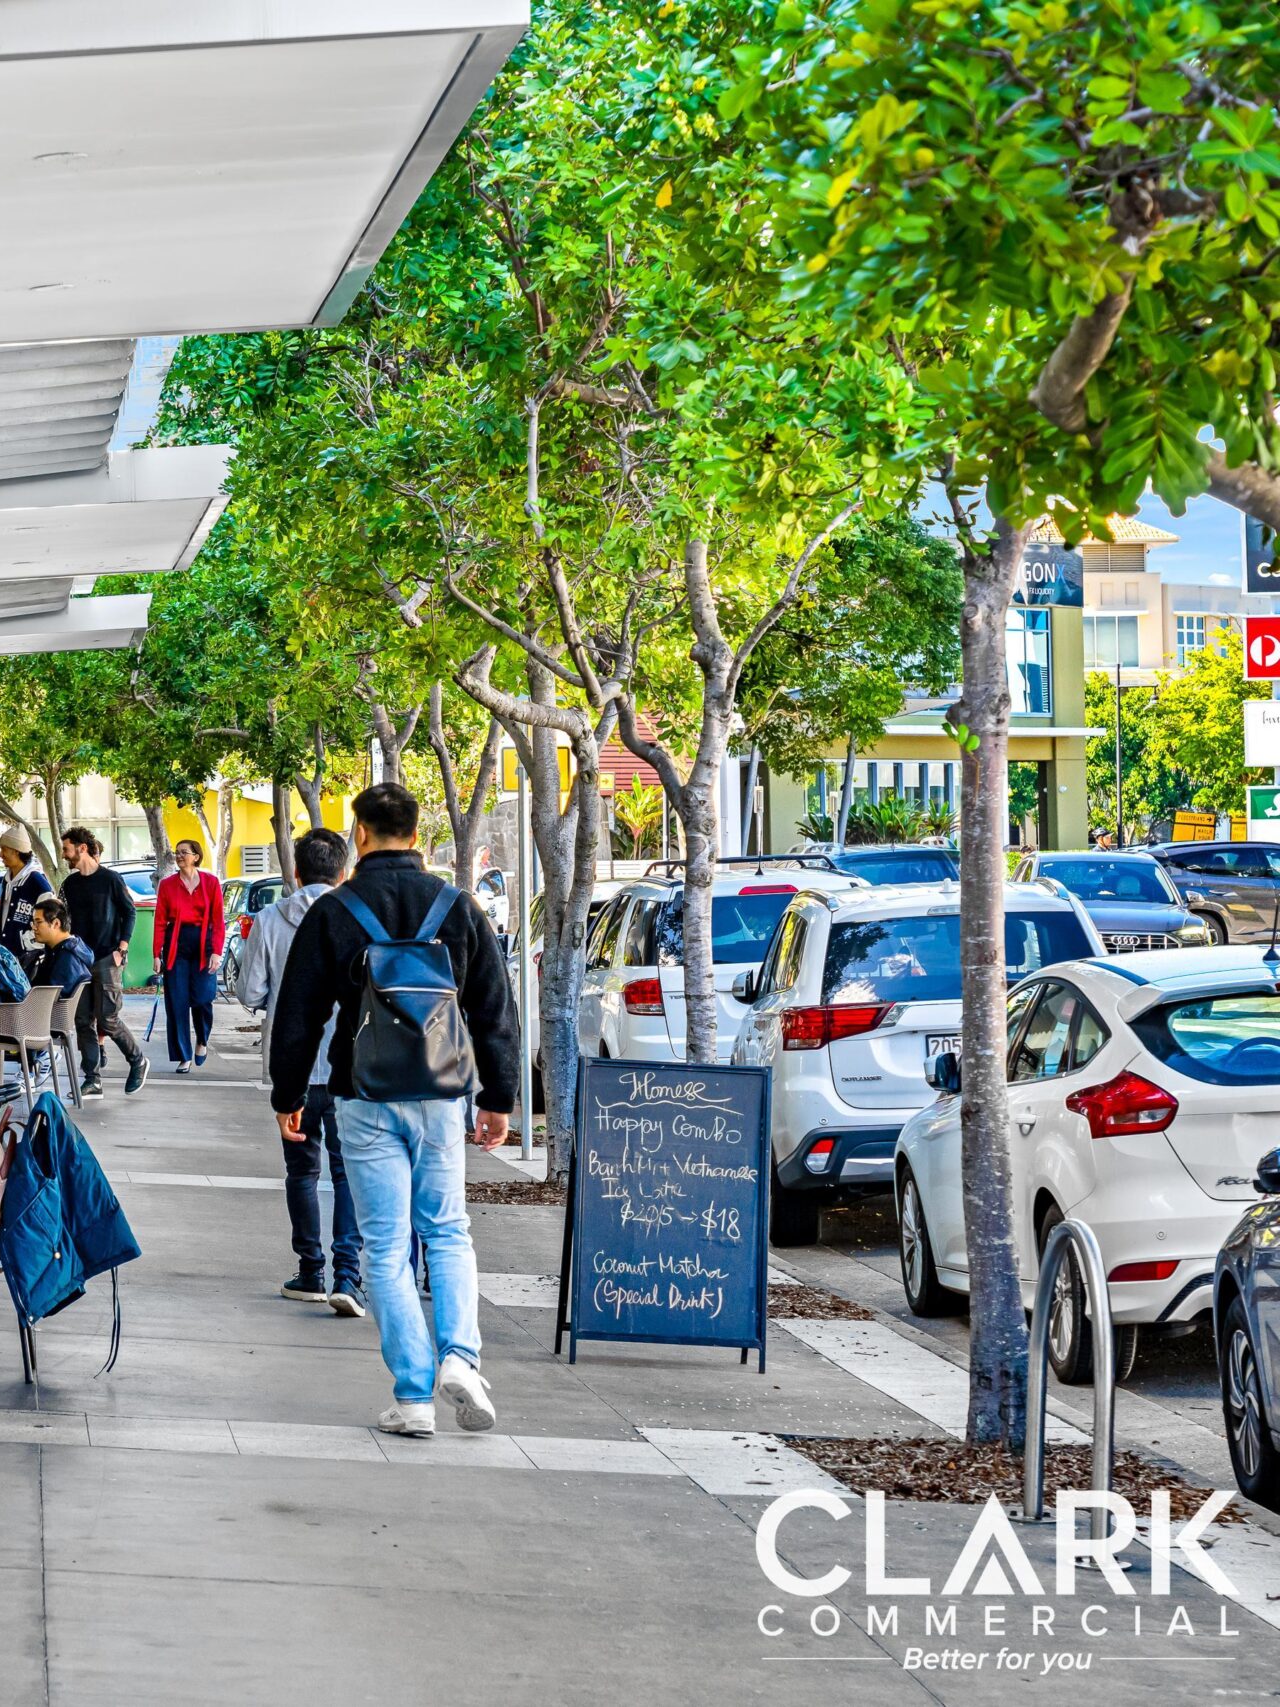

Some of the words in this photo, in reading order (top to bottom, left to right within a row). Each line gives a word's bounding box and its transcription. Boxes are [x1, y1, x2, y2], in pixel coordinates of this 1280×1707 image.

[1020, 561, 1065, 584] GONX
[15, 901, 34, 916] 199
[930, 1038, 962, 1057] 205
[619, 1072, 732, 1102] Homese
[594, 1108, 663, 1153] Happy
[1215, 1175, 1253, 1187] Focu
[700, 1200, 742, 1239] $18
[593, 1249, 656, 1277] Coconut
[658, 1252, 729, 1280] Matcha
[593, 1277, 664, 1320] (Special
[668, 1283, 723, 1319] Drink)
